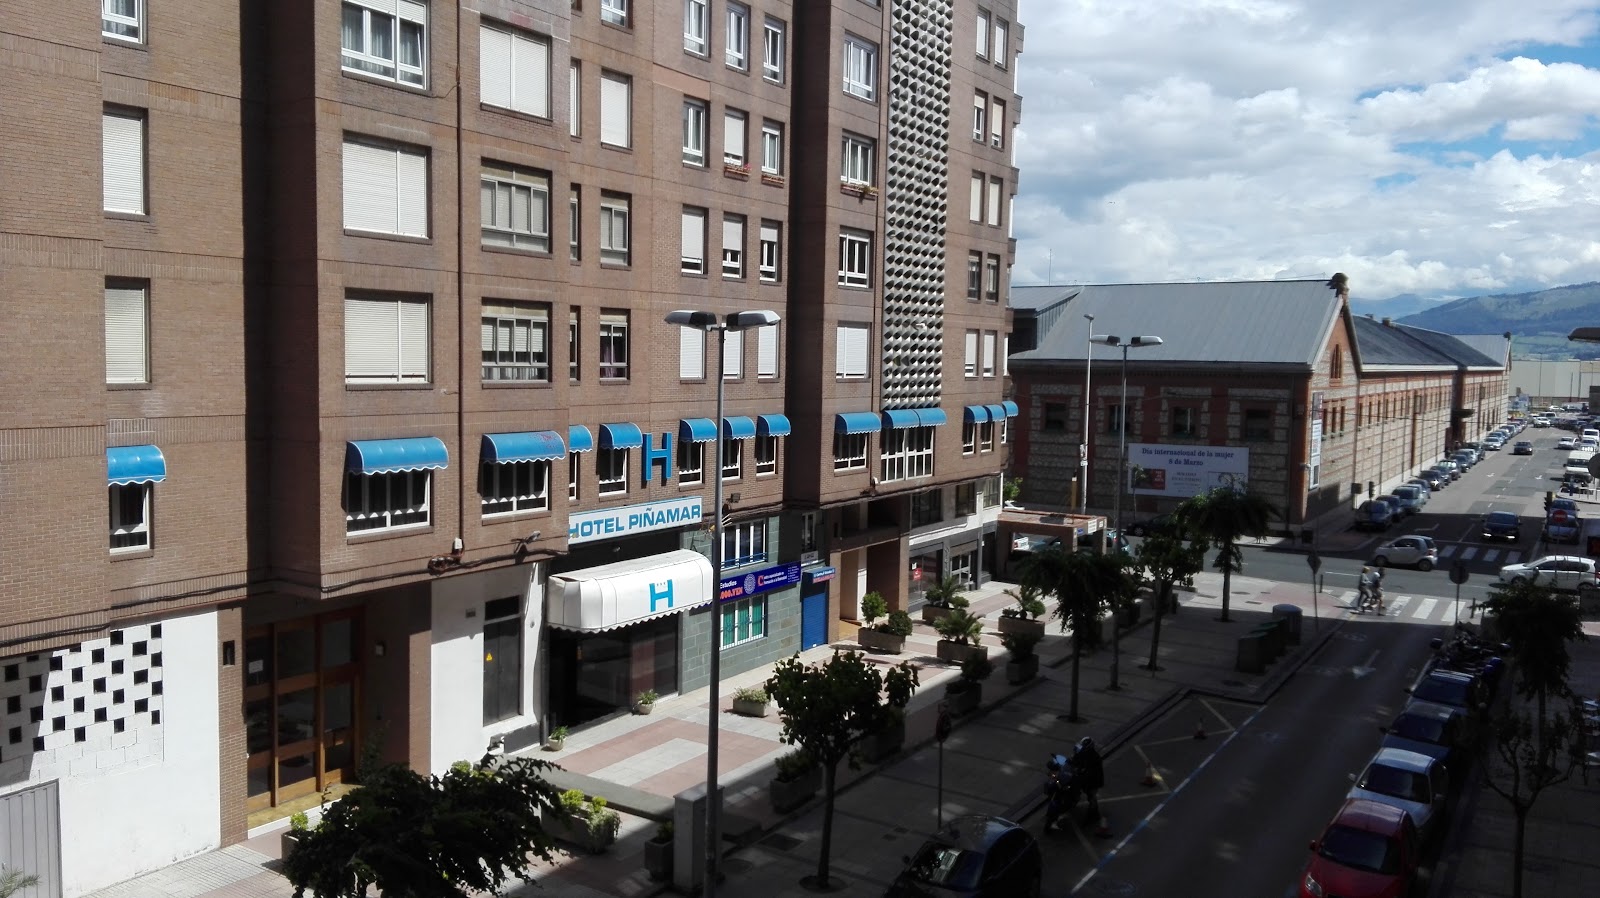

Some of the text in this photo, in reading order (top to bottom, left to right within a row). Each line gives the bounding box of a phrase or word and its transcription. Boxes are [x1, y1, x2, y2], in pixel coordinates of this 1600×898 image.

[646, 432, 672, 480] H
[569, 504, 701, 539] HOTEL PIÑAMAR
[649, 579, 673, 612] H
